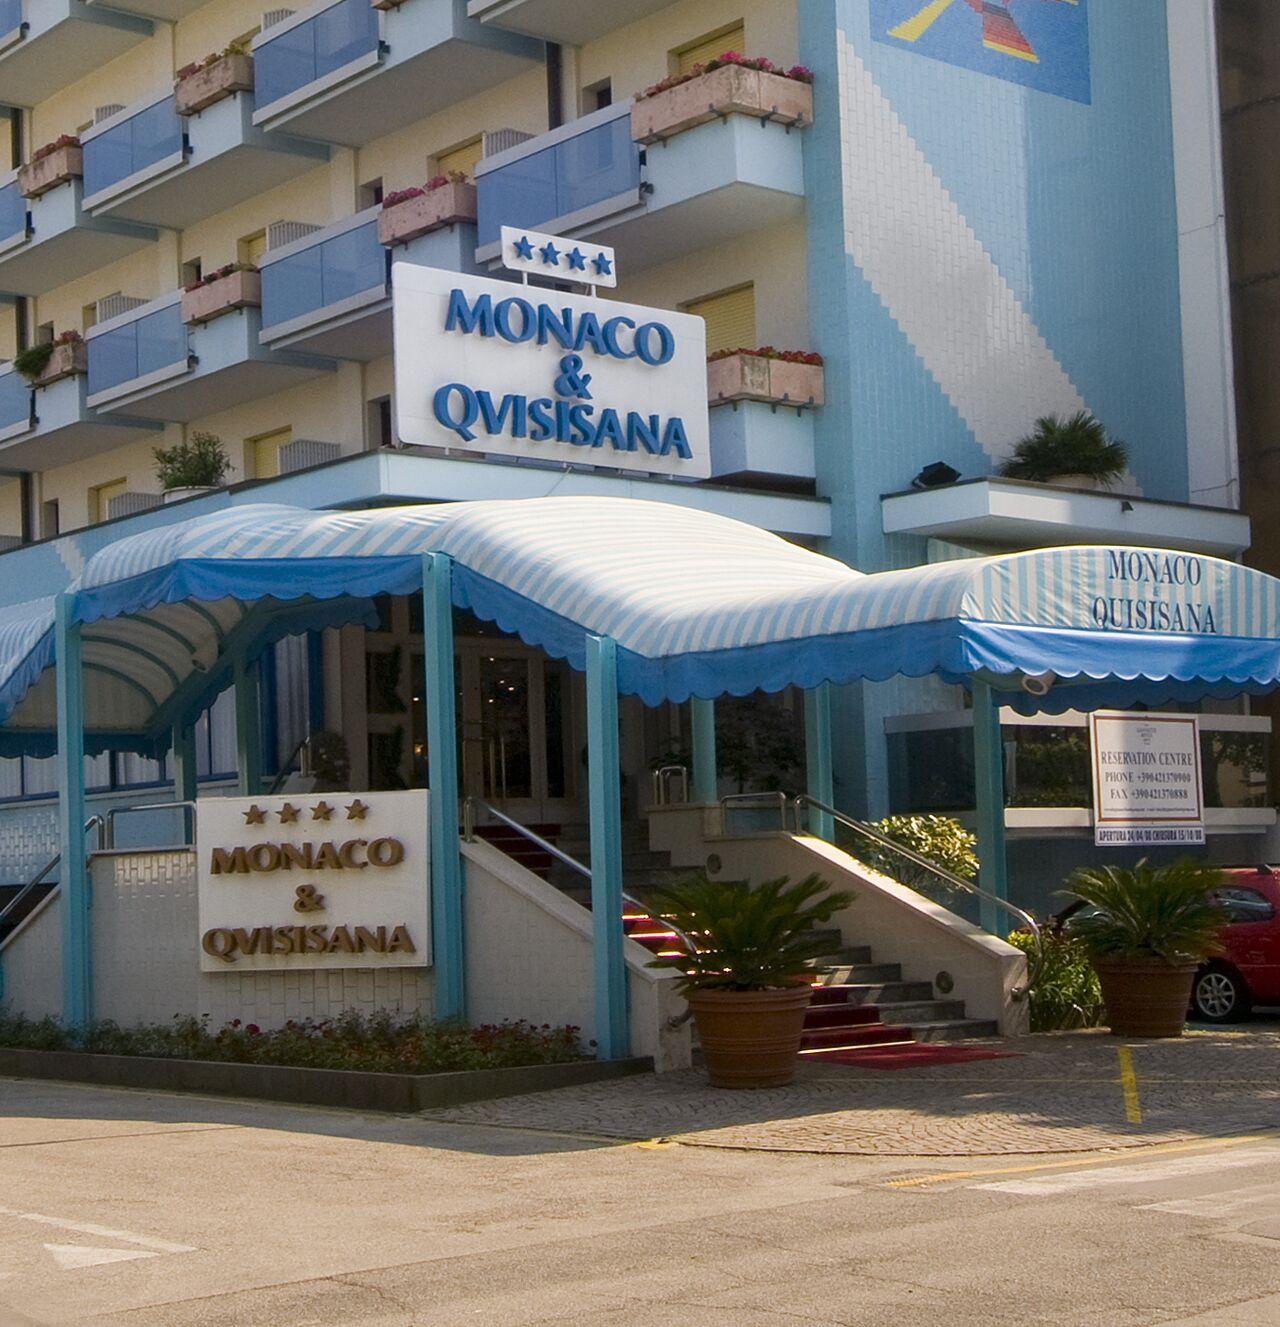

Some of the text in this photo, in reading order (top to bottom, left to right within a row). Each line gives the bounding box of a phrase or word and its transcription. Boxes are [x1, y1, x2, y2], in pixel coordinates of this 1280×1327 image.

[445, 288, 675, 366] MONACO
[554, 354, 593, 399] &
[433, 383, 693, 459] QVISISANA
[1108, 550, 1201, 585] MONACO
[1092, 597, 1217, 633] QUISISANA
[1101, 752, 1193, 766] RESERVATION CENTRE
[1105, 772, 1134, 783] PHONE
[1110, 788, 1128, 799] FAX
[1099, 830, 1127, 841] APERTURA
[1153, 830, 1177, 841] CHIUSURA
[210, 837, 405, 874] MONACO
[294, 884, 326, 913] &
[202, 924, 416, 963] QVISISANA
